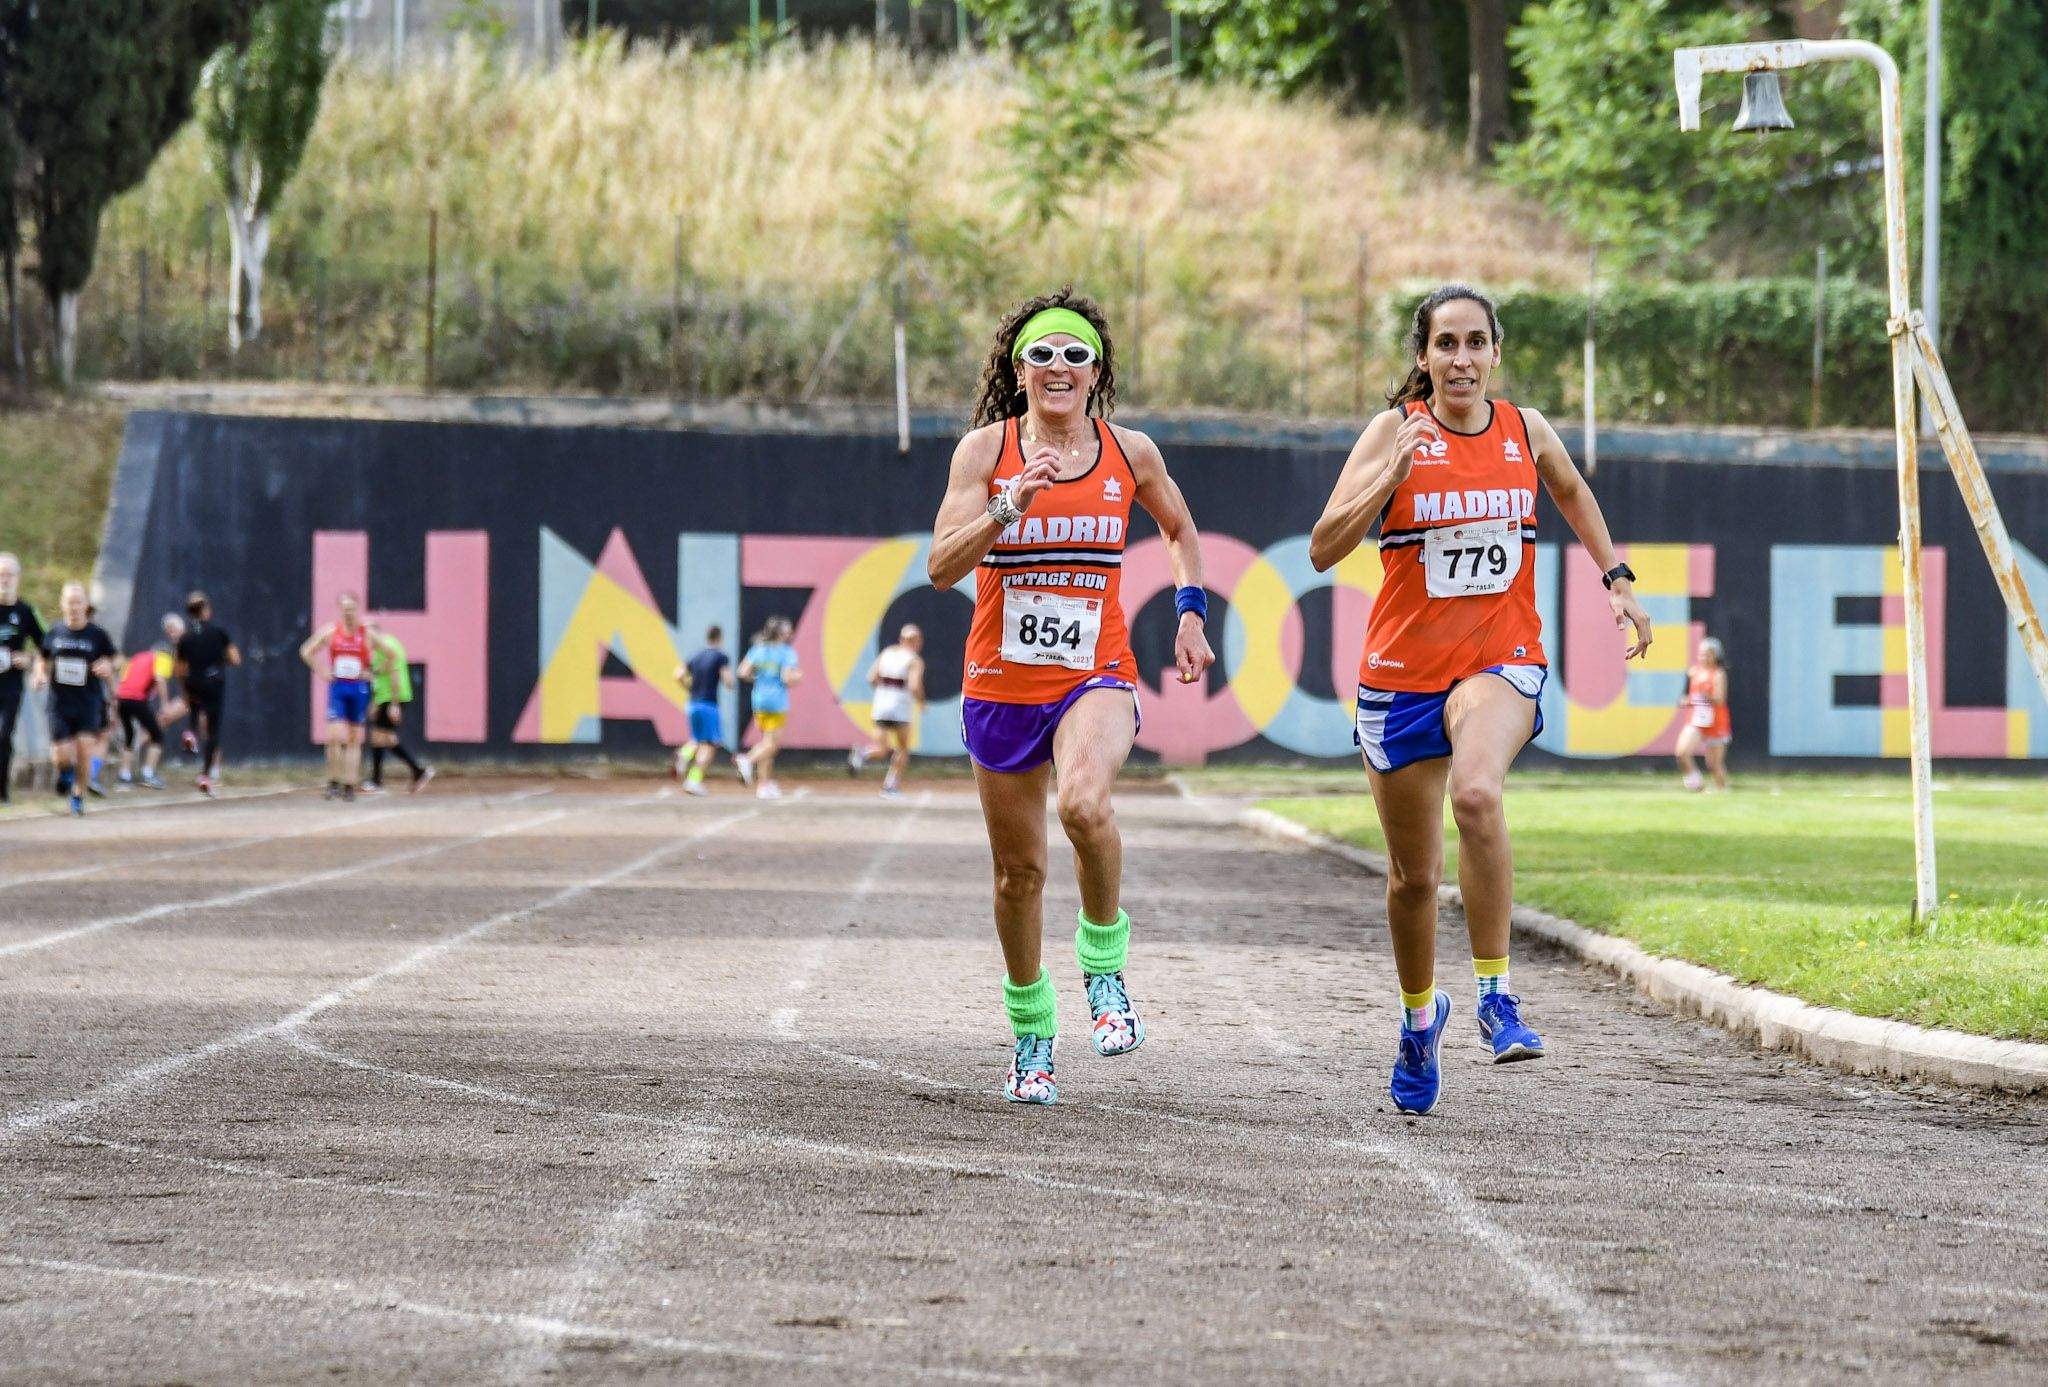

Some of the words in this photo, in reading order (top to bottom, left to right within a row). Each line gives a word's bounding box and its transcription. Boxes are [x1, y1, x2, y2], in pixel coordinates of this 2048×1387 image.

[1413, 488, 1534, 522] MADRID
[1443, 544, 1507, 579] 779
[1073, 573, 1108, 590] RUN
[1019, 613, 1082, 650] 854
[1072, 656, 1089, 664] 2023
